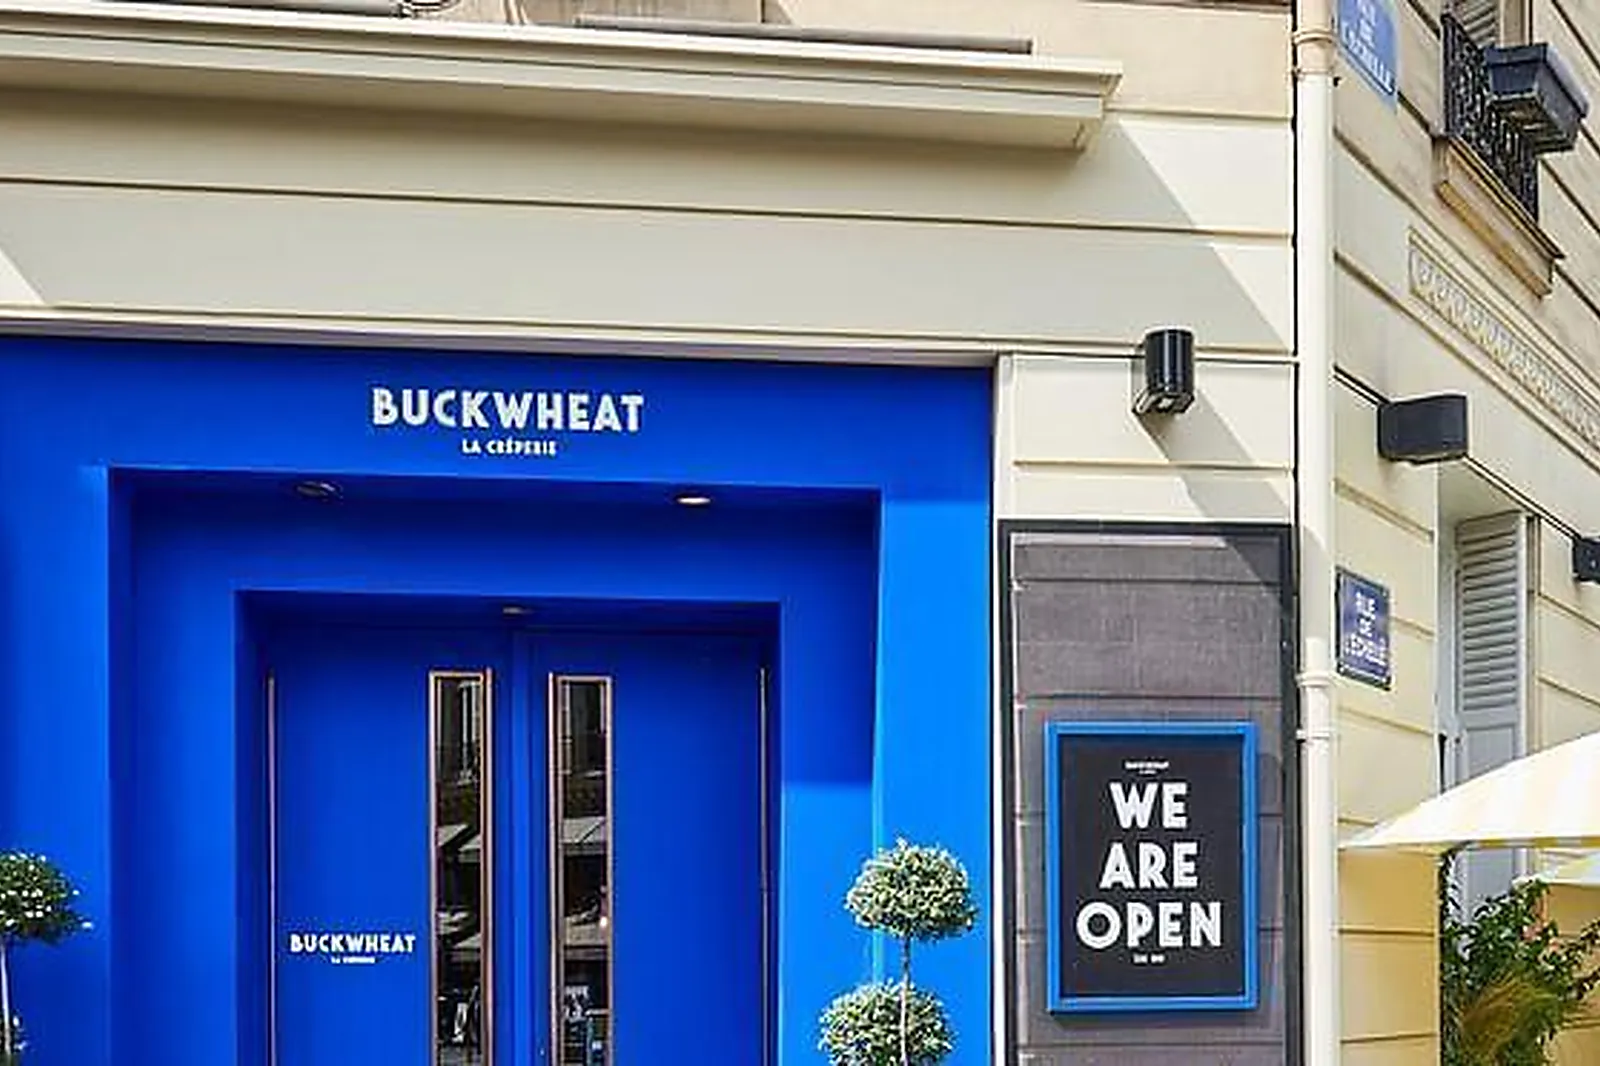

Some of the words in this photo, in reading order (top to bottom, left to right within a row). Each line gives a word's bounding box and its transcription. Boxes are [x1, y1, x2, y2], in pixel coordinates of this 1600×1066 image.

[372, 388, 644, 432] BUCKWHEAT
[461, 438, 482, 455] LA
[1109, 782, 1188, 829] WE
[1099, 841, 1198, 889] ARE
[290, 933, 416, 953] BUCKWHEAT
[1076, 901, 1222, 949] OPEN
